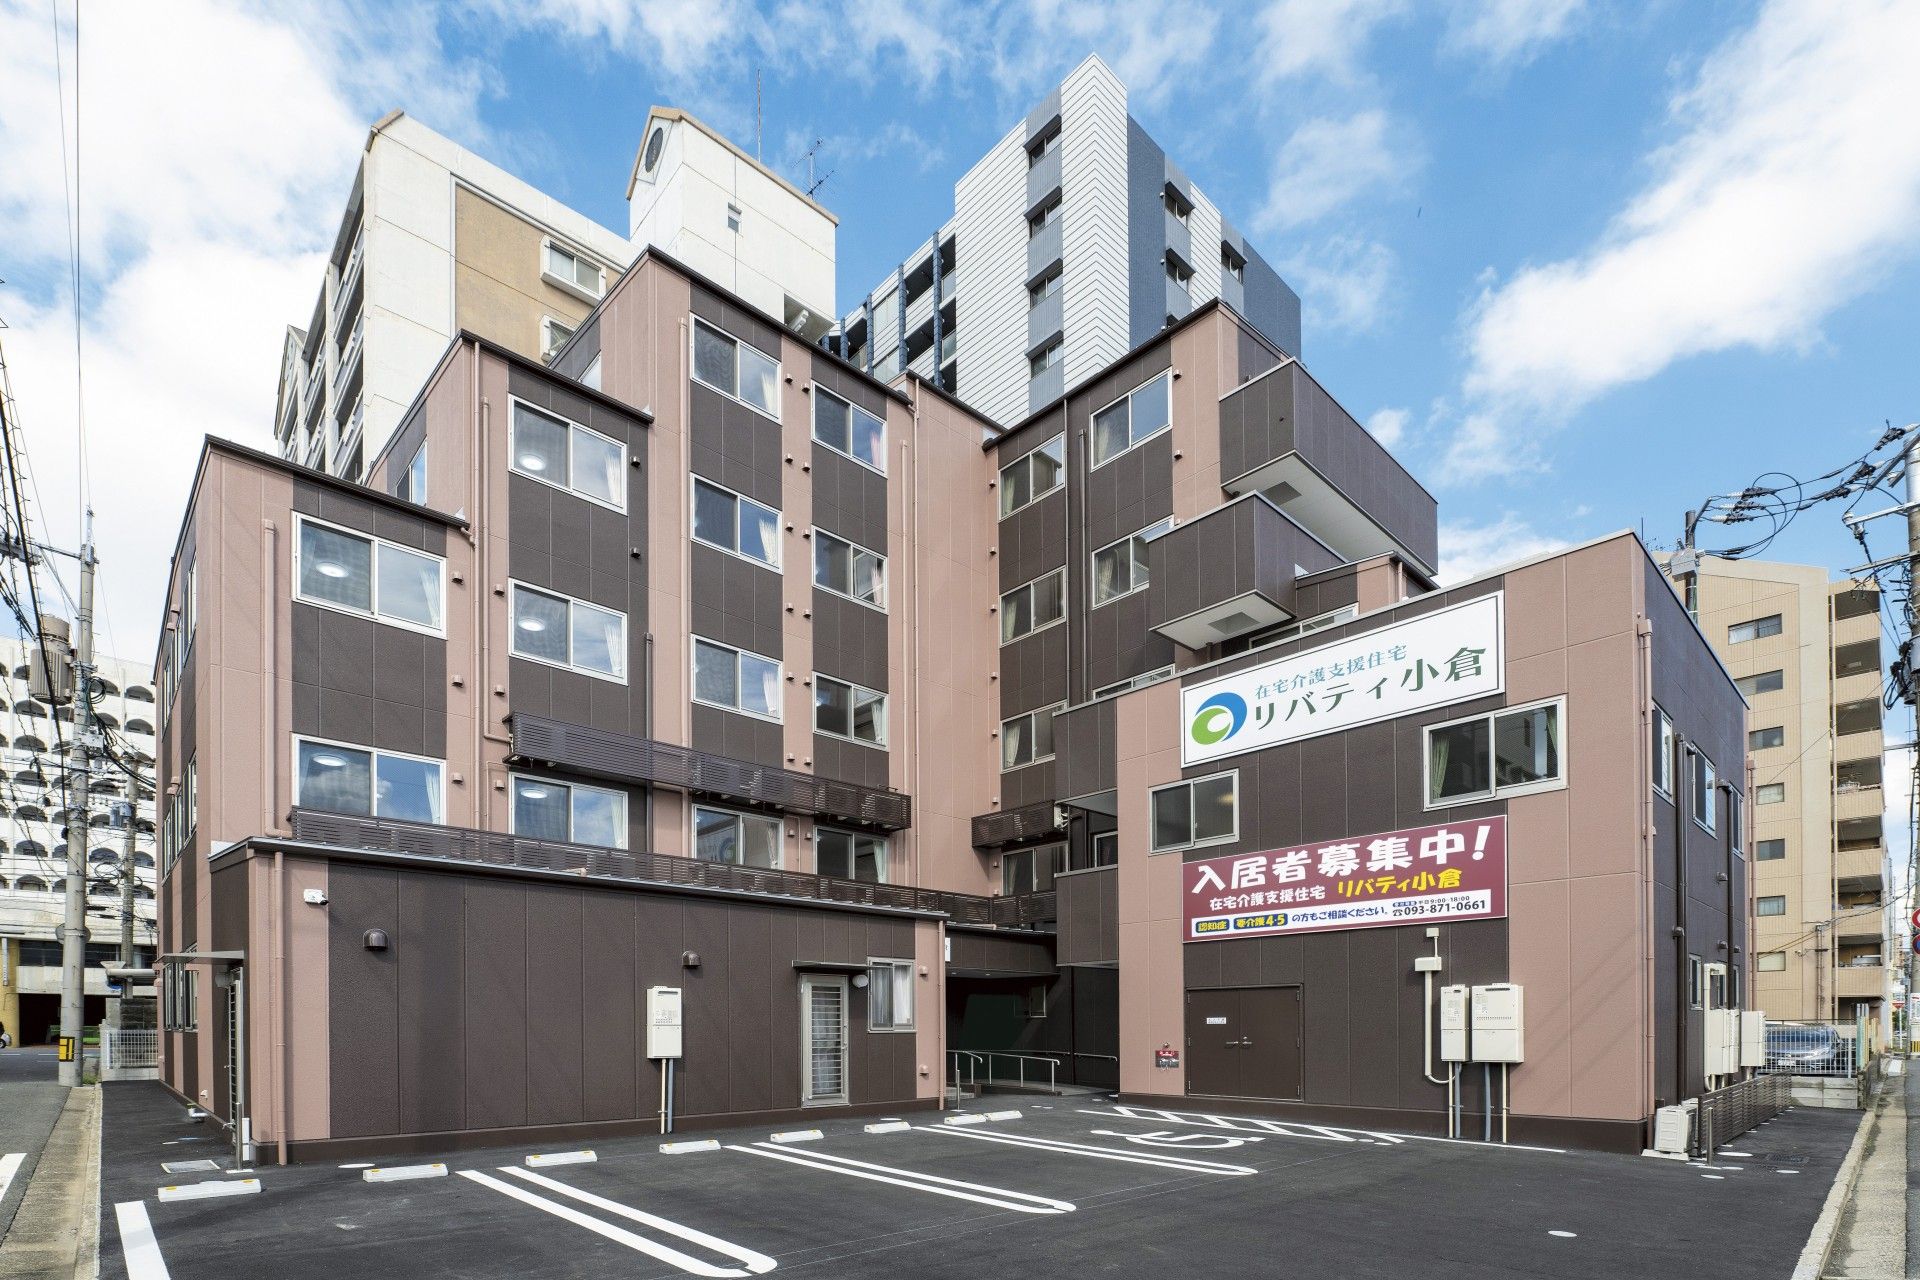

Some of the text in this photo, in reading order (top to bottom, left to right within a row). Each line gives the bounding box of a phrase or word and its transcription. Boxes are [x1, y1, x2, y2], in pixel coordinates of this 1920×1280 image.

[1254, 644, 1407, 700] 在宅介護支援住宅
[1255, 646, 1487, 730] リバティ小倉
[1209, 868, 1463, 911] 在宅介護支援住宅 リバティ小倉
[1404, 900, 1486, 916] 093-871-0661
